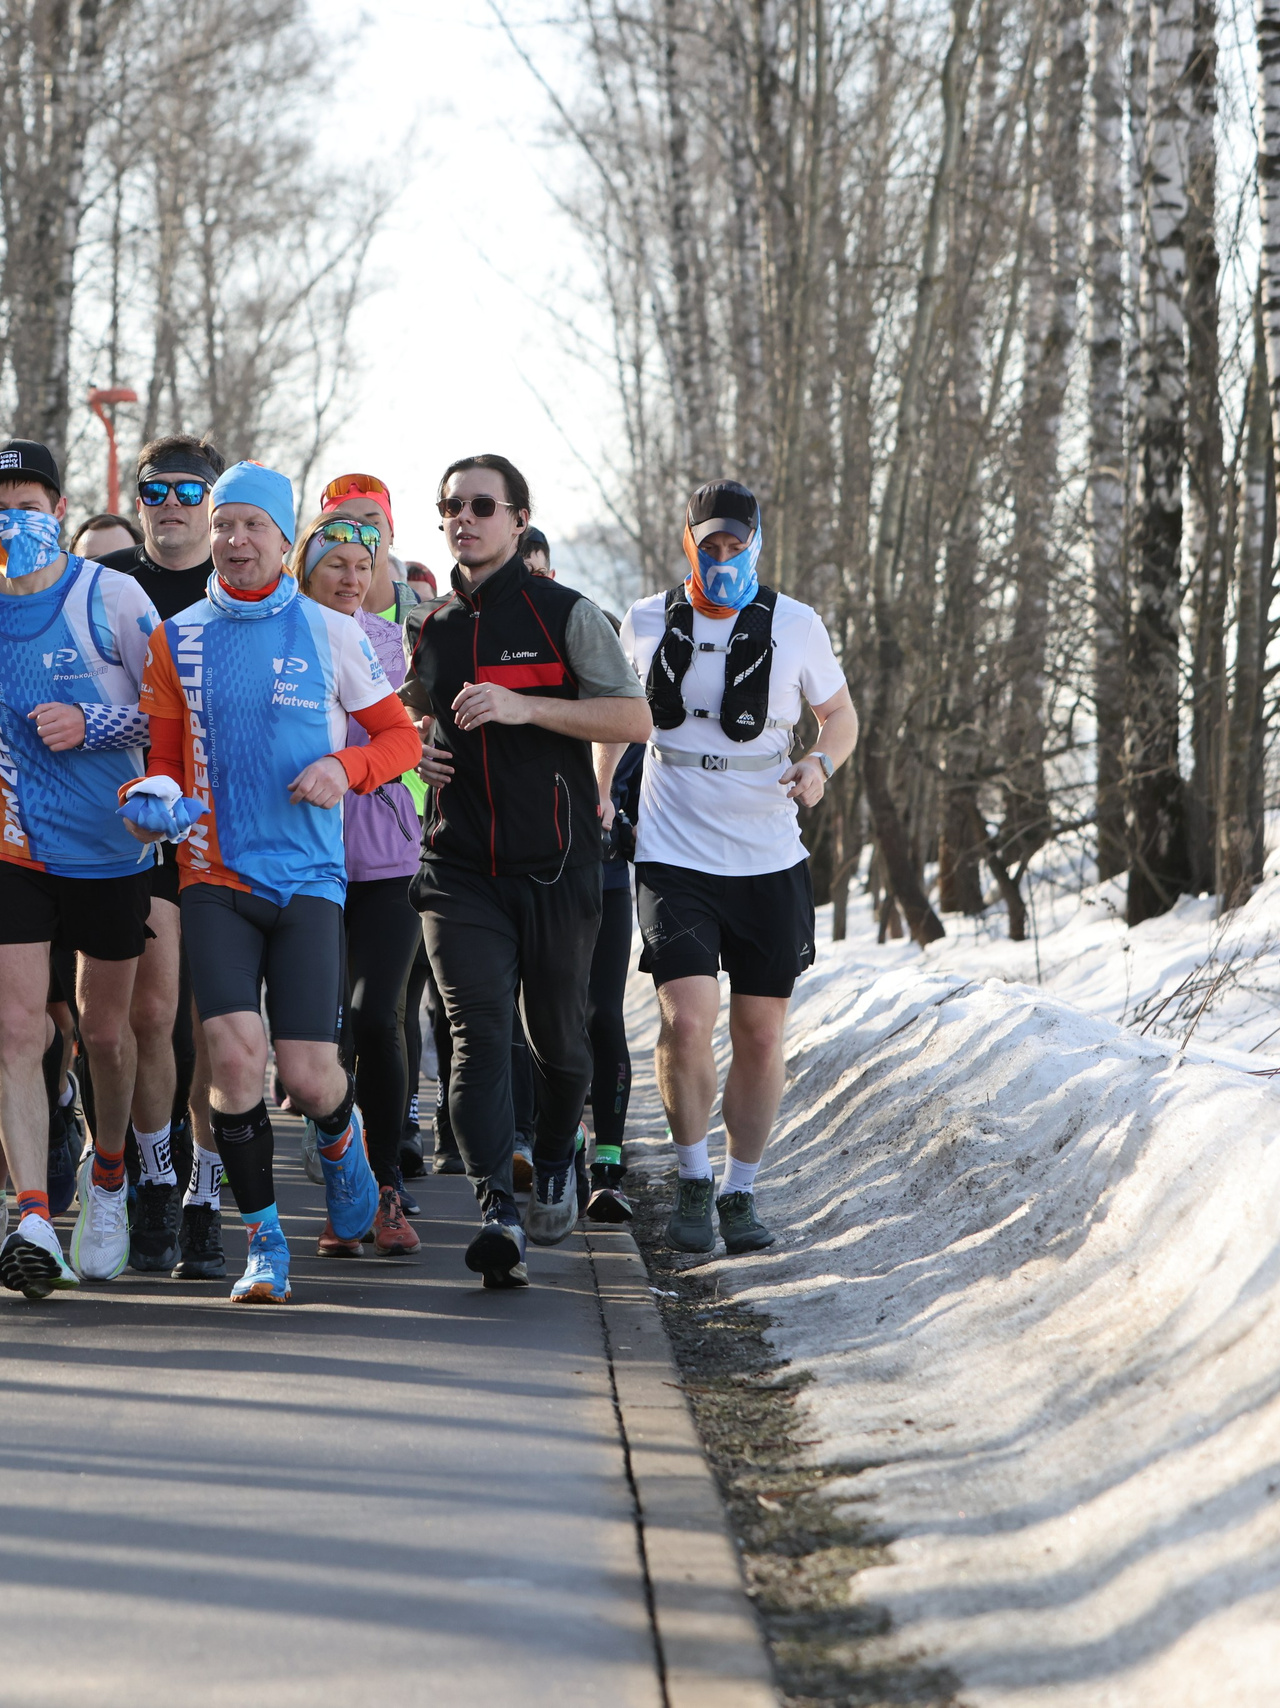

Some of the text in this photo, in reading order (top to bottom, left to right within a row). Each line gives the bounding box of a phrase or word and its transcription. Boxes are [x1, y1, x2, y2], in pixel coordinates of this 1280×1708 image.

[273, 679, 298, 693] Igor
[271, 693, 320, 710] Matveev
[205, 667, 220, 788] Dolgoprudny running club
